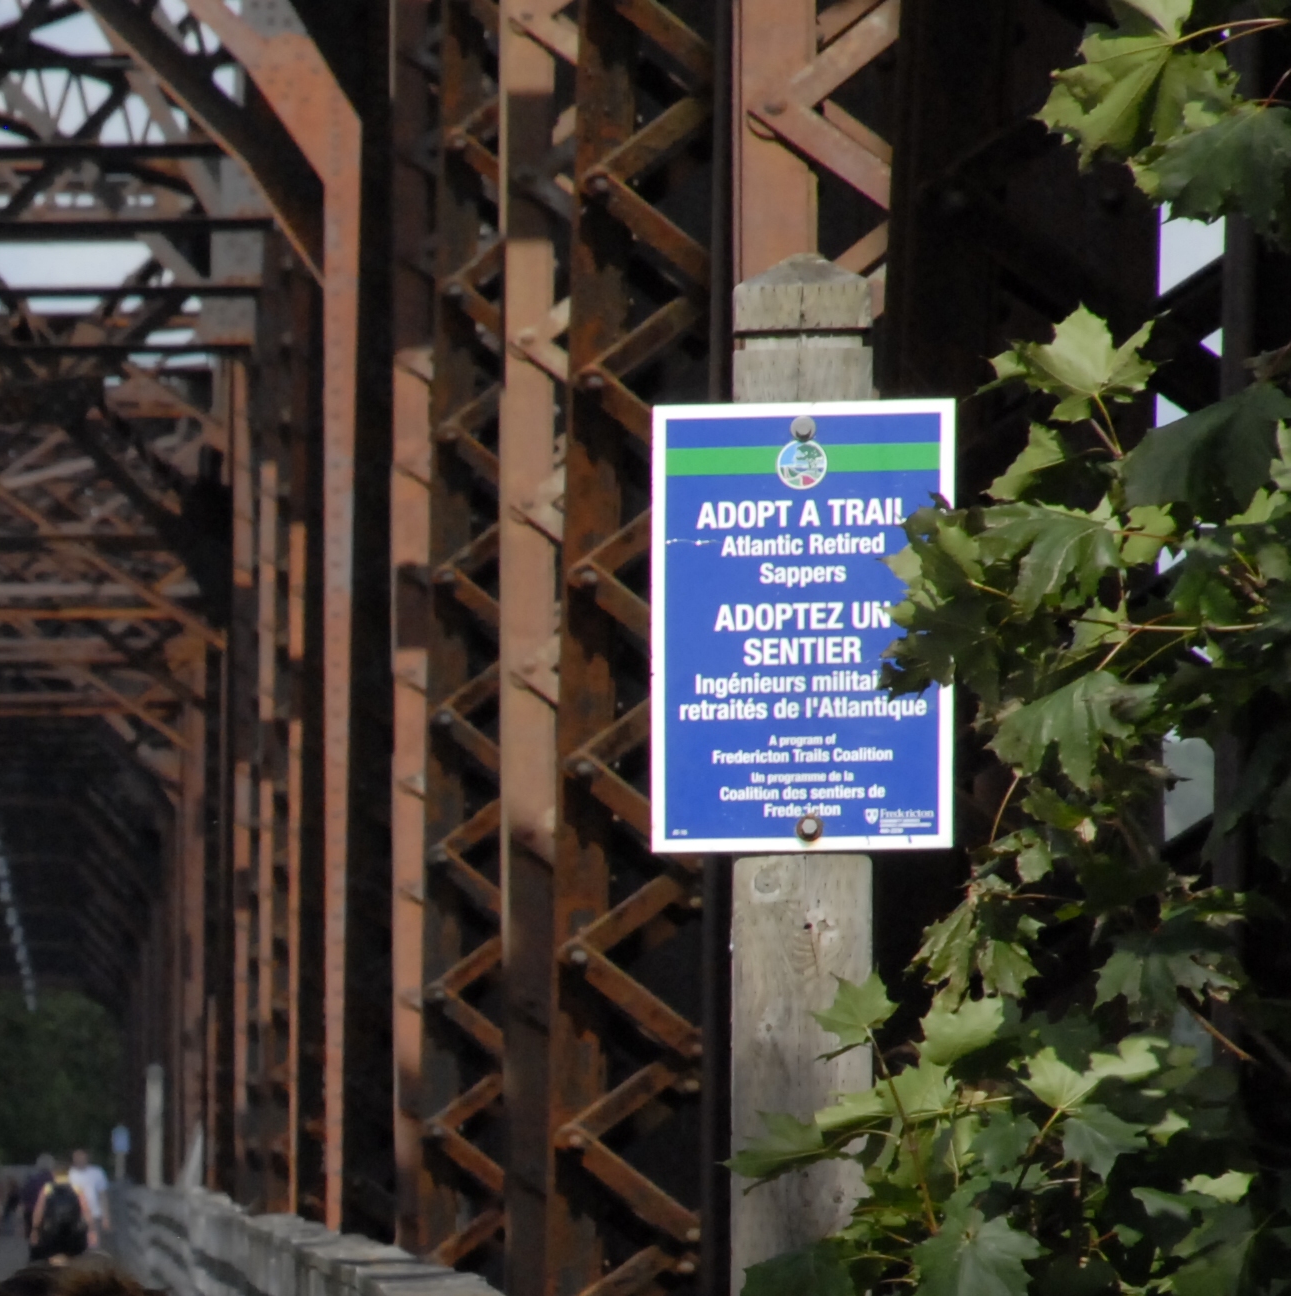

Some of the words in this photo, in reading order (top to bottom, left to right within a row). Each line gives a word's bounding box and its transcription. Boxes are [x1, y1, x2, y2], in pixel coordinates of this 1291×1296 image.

[696, 500, 792, 529] ADOPT
[799, 500, 820, 527] A
[828, 498, 907, 526] TRAIL
[721, 534, 803, 557] Atlantic
[809, 532, 885, 554] Retired
[760, 563, 846, 588] Sappers
[714, 602, 844, 631] ADOPTEZ
[852, 601, 891, 629] UN
[743, 636, 861, 666] SENTIER
[695, 672, 806, 698] Ingénieurs
[812, 670, 880, 693] militai
[679, 698, 768, 721] retraités
[774, 698, 799, 719] de
[806, 696, 927, 721] l'Atlantique
[769, 735, 777, 745] A
[780, 735, 823, 748] program
[825, 734, 836, 745] of
[712, 750, 789, 764] Fredericton
[793, 749, 829, 763] Trails
[833, 747, 892, 762] Coalition
[751, 773, 765, 783] Un
[768, 773, 826, 784] programme
[829, 772, 841, 782] de
[844, 771, 853, 782] la
[720, 787, 779, 801] Coalition
[783, 787, 807, 800] des
[810, 786, 865, 799] sentiers
[868, 785, 885, 797] de
